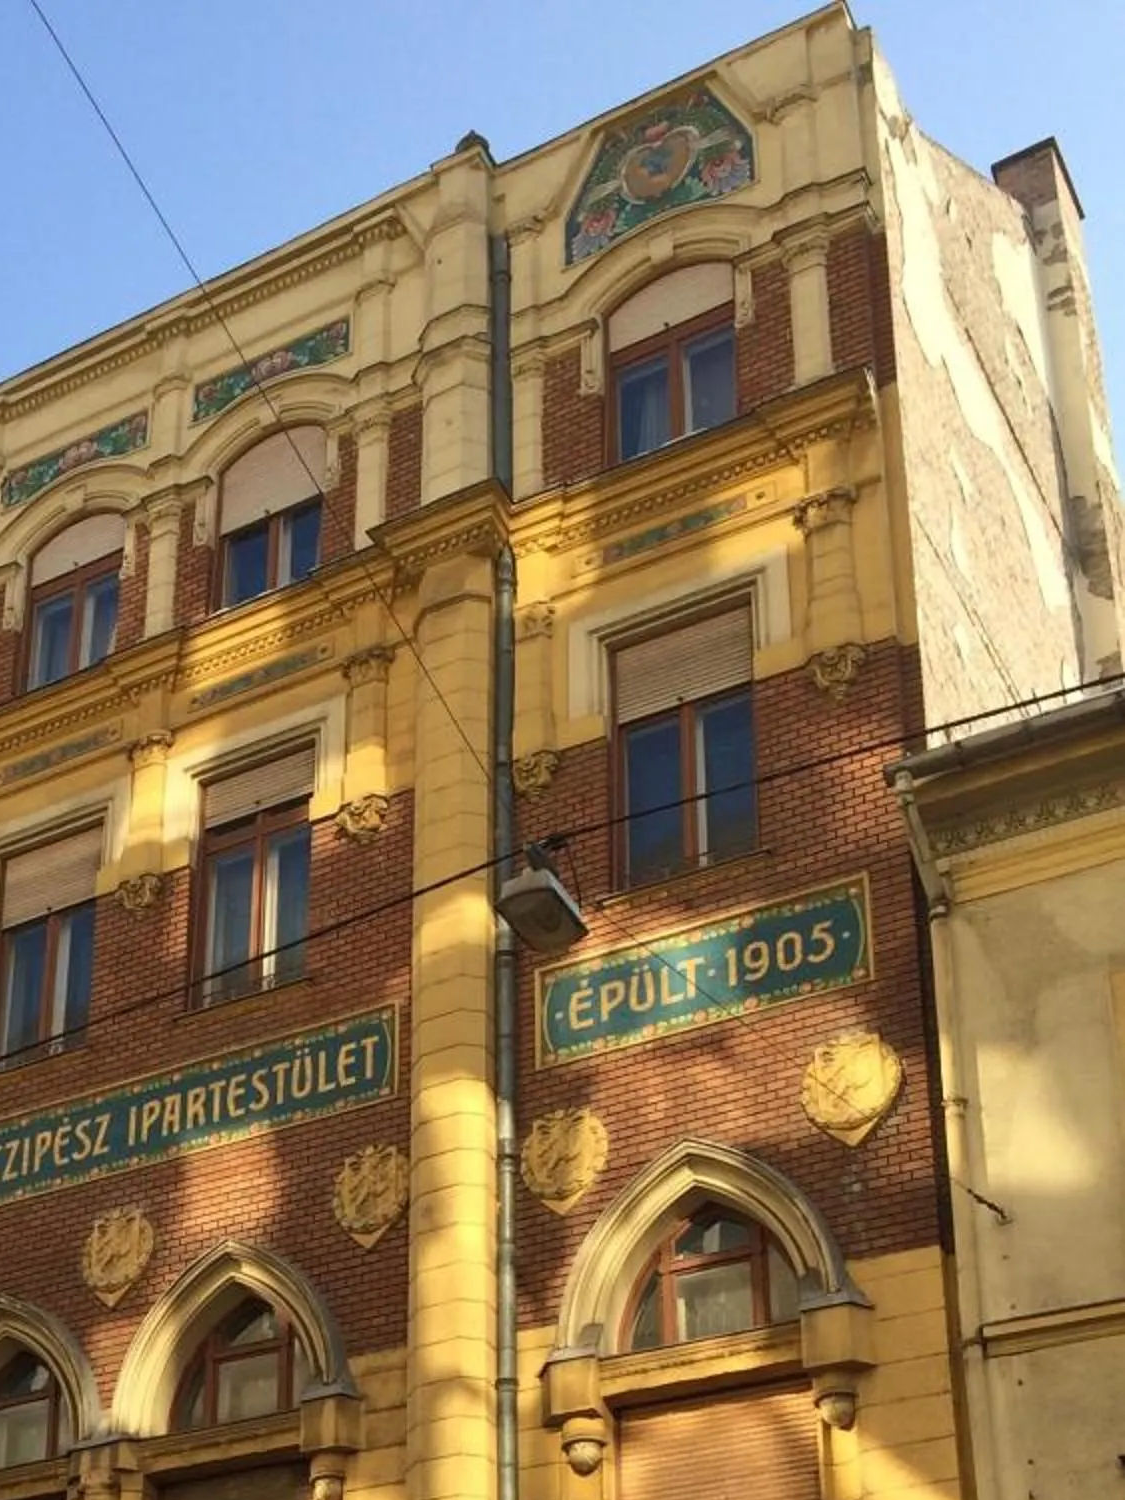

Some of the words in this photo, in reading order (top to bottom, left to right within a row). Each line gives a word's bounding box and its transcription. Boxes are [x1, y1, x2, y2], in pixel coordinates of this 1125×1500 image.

[567, 955, 706, 1030] ÉPÜLT
[725, 920, 836, 988] 1905
[127, 1035, 380, 1147] IPARTESTÜLET
